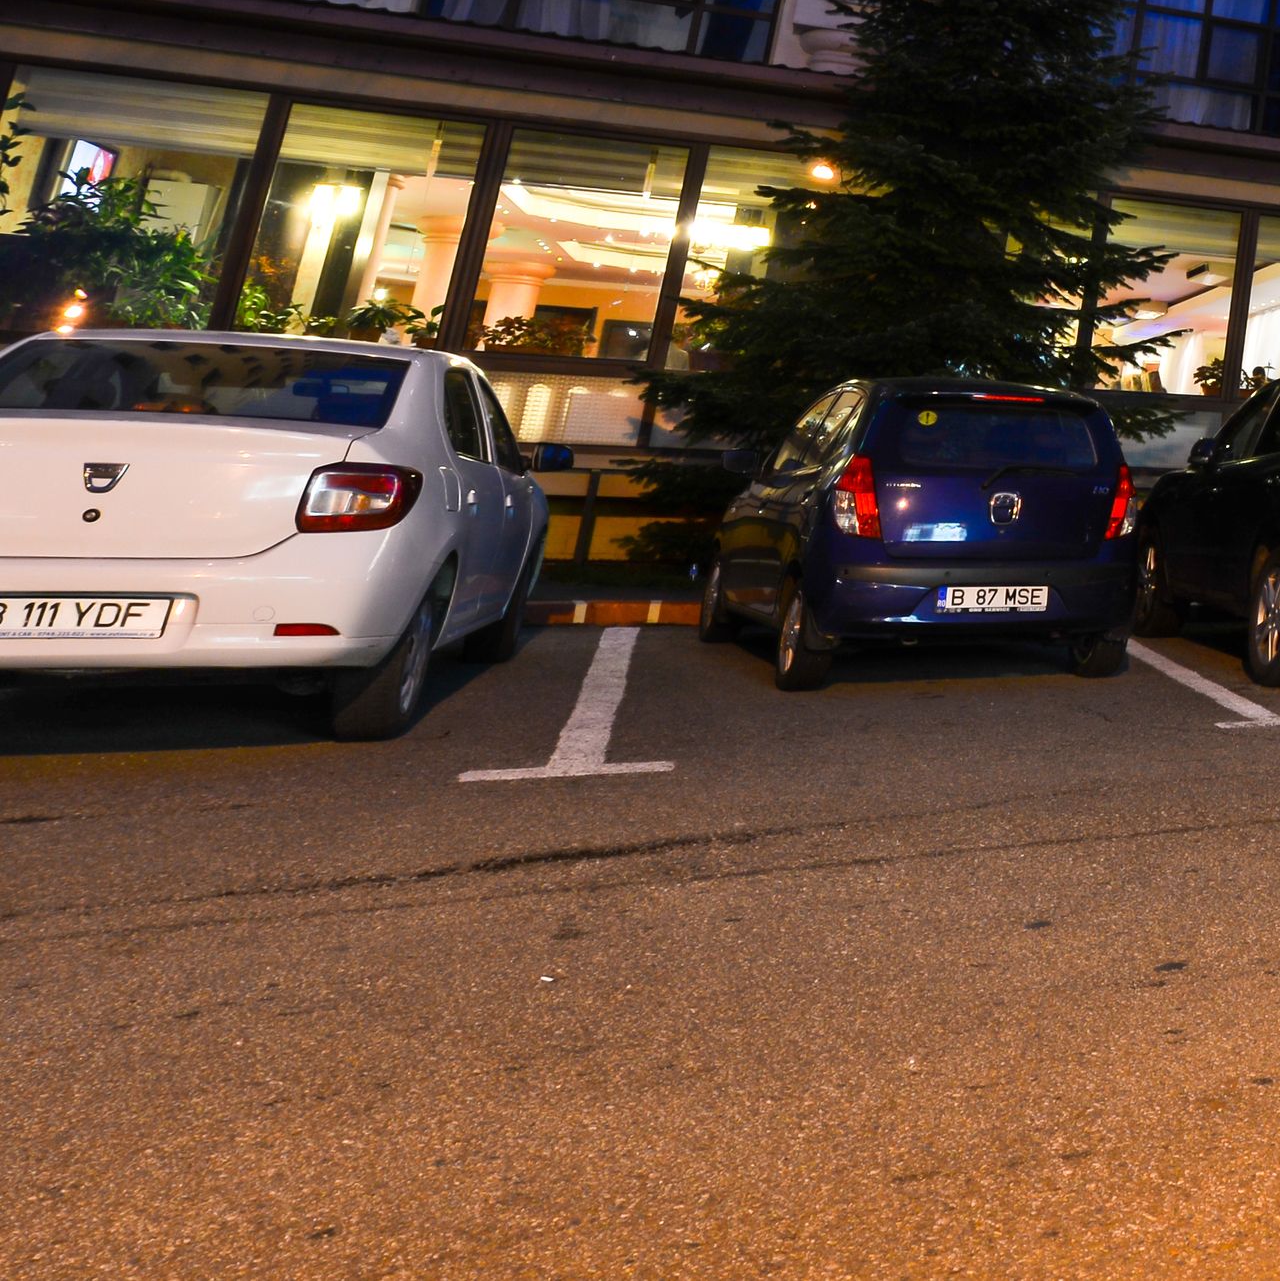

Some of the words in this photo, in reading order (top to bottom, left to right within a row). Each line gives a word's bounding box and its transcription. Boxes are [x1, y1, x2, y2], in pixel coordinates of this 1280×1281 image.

[936, 599, 946, 608] RO
[951, 589, 965, 606] B
[976, 589, 999, 606] 87
[1004, 588, 1044, 606] MSE
[22, 602, 61, 627] 111
[75, 602, 152, 628] YDF
